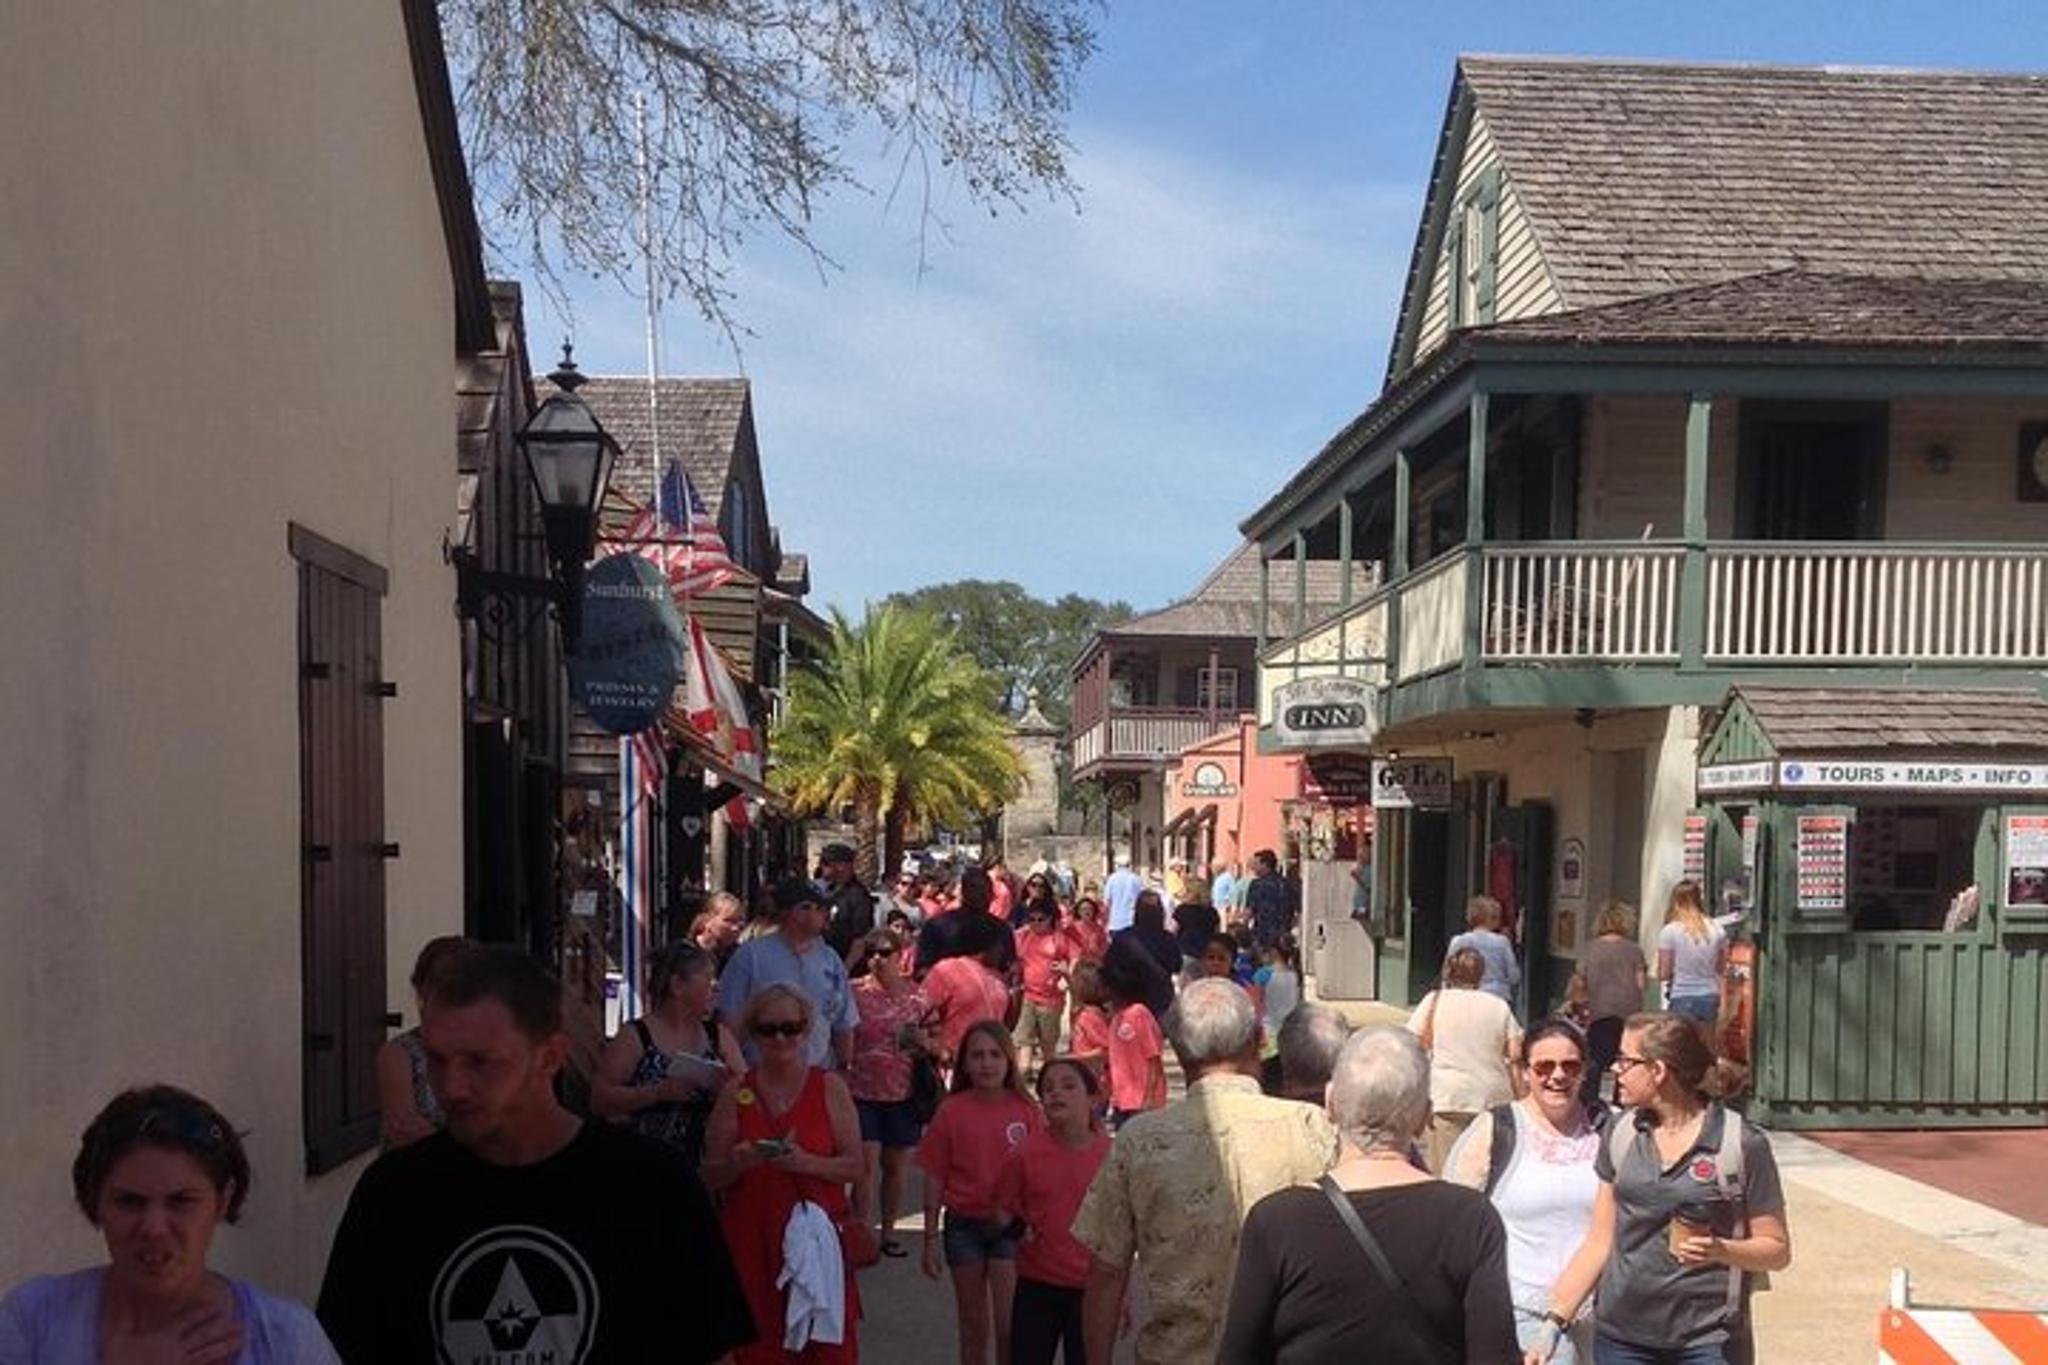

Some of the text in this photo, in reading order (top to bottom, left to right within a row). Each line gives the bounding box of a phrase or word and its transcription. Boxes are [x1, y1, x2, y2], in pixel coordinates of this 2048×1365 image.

[585, 580, 664, 600] Sunburst
[1299, 707, 1352, 726] INN
[1818, 766, 2032, 783] TOURS MAPS INFO
